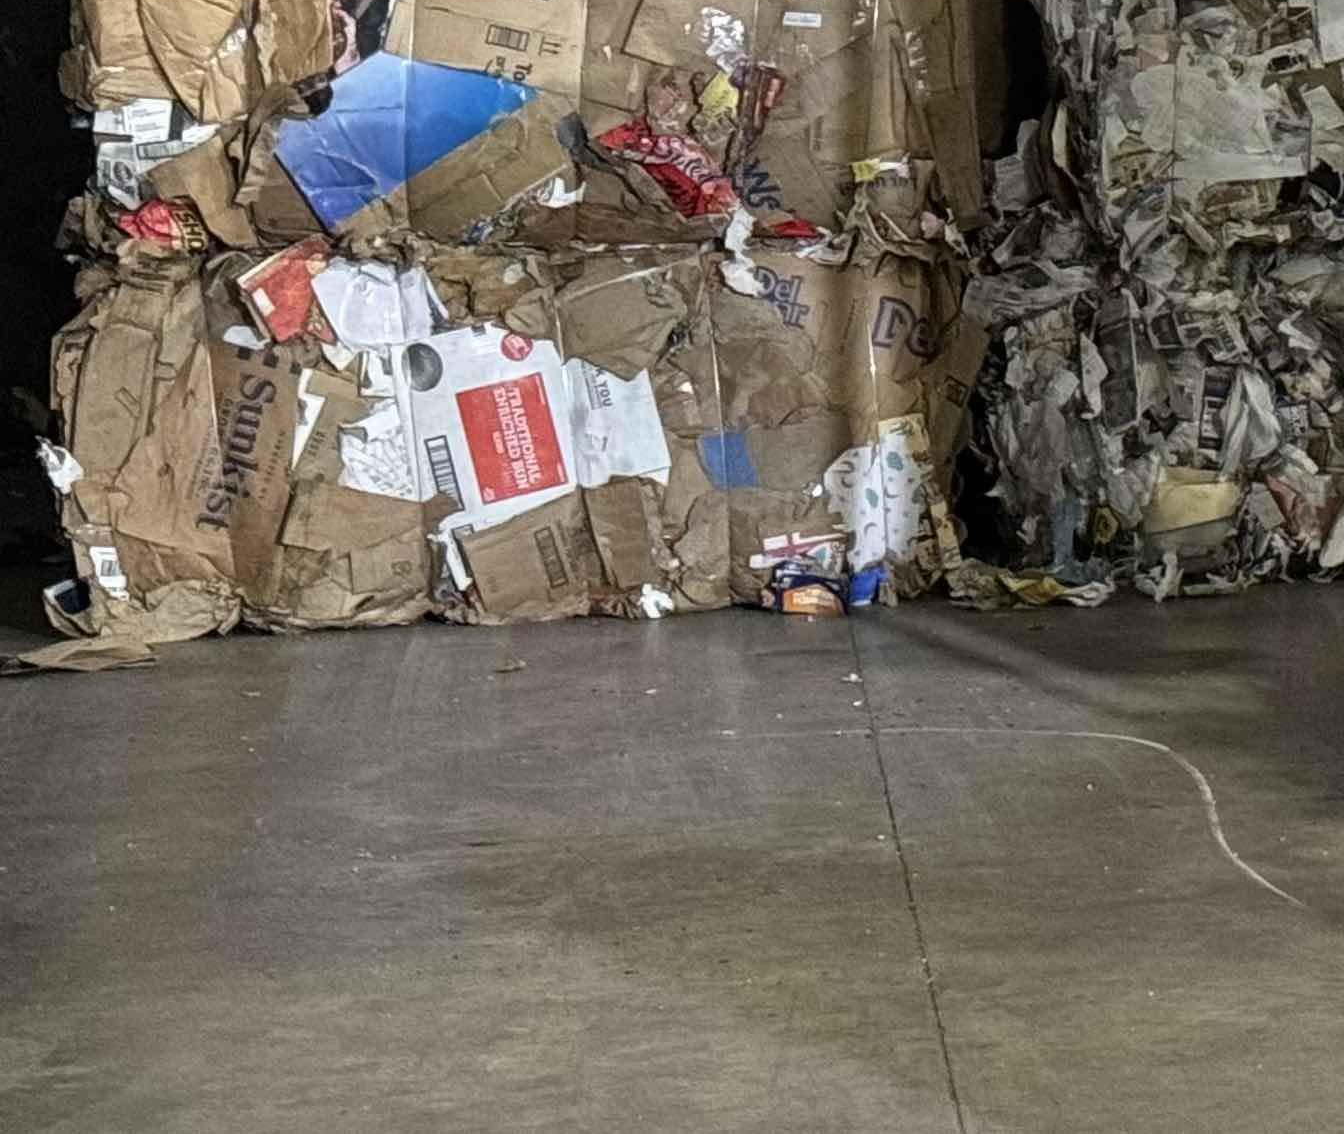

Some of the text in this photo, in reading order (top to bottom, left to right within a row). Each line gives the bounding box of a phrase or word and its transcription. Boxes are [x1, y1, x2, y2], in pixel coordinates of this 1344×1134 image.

[494, 386, 529, 489] ENRICHED BUN
[507, 386, 542, 484] TRADITIONAL
[597, 380, 614, 408] YOU
[196, 370, 277, 528] Sunkist
